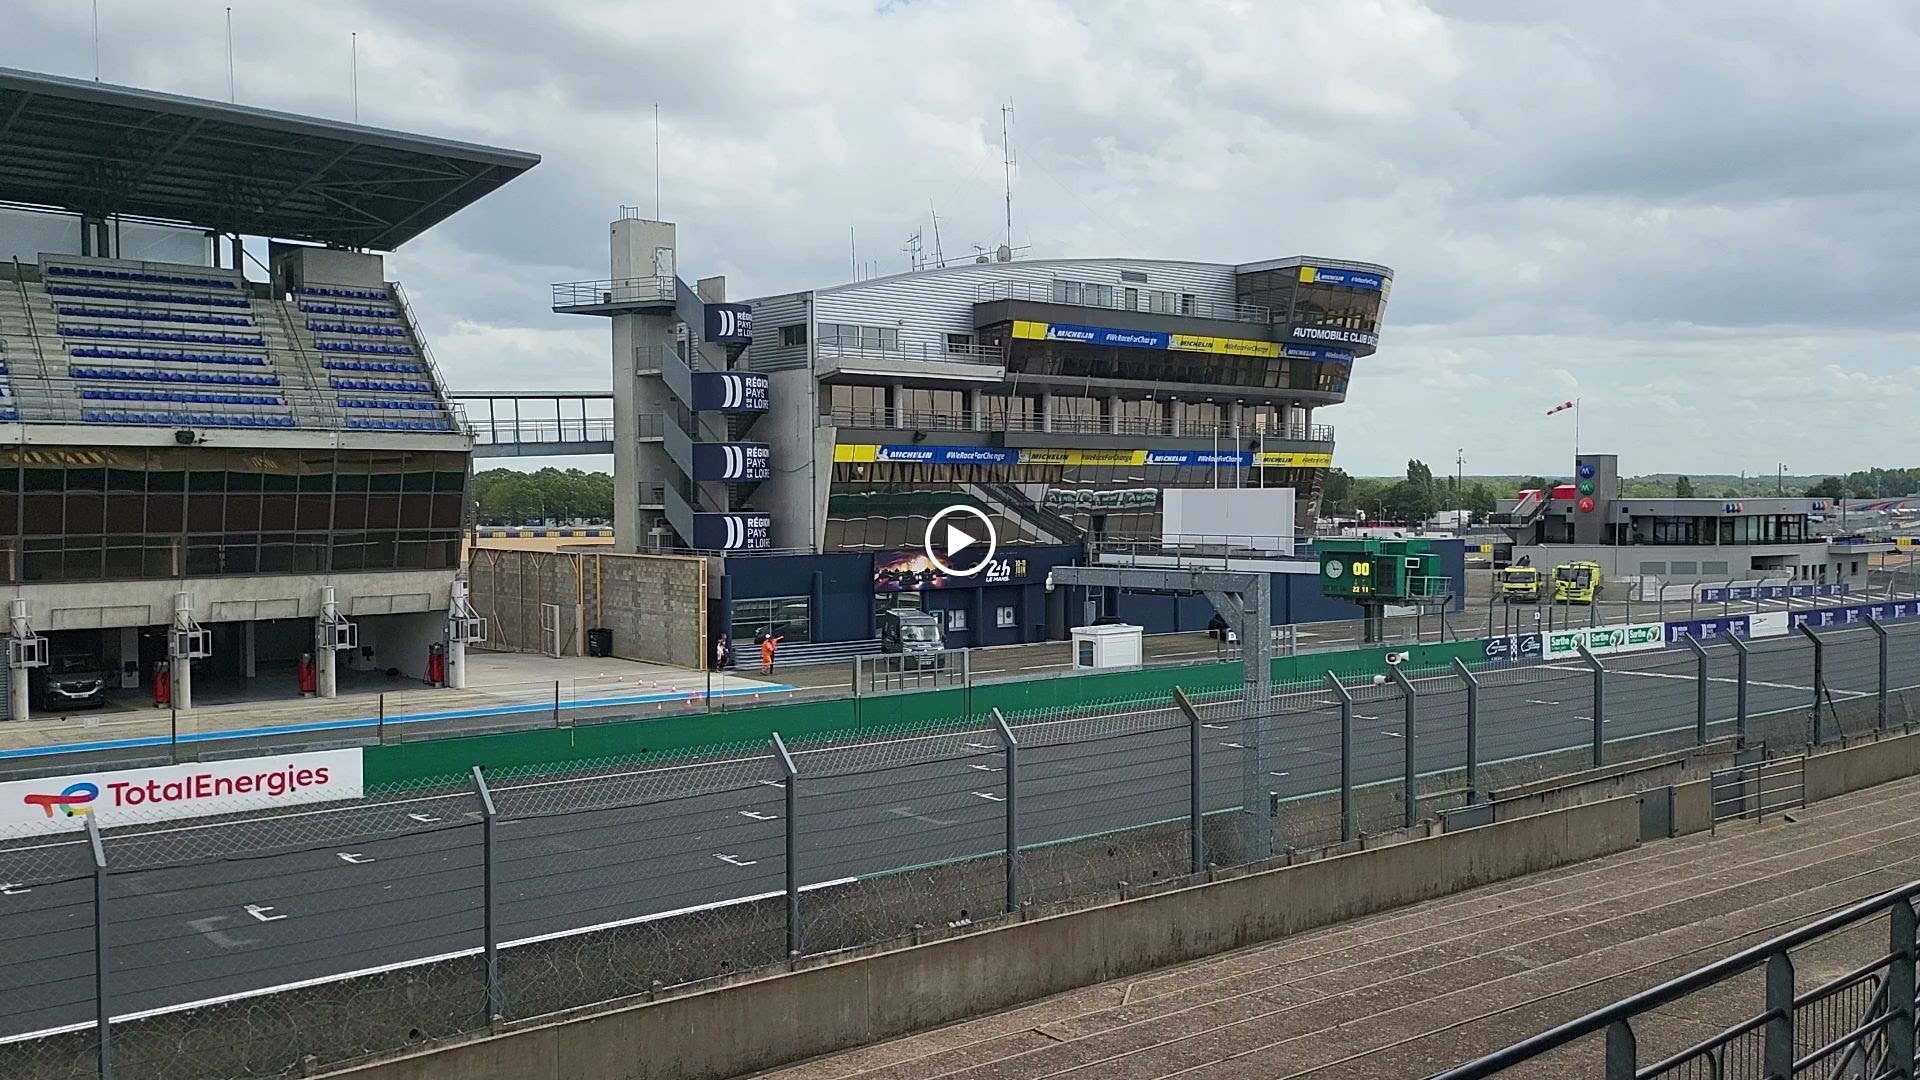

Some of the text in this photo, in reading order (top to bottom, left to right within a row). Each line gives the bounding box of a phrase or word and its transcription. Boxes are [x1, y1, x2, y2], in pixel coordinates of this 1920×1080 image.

[1057, 330, 1094, 339] MICHELIN
[1293, 327, 1349, 341] AUTOMOBILE
[1350, 332, 1367, 344] CLUB
[1180, 340, 1213, 349] MICHELIN
[745, 388, 765, 398] PAYS
[890, 451, 1005, 461] MICHELIN #WeRaceForChange
[746, 458, 765, 467] PAYS
[747, 528, 766, 537] PAYS
[1352, 562, 1370, 576] 00
[107, 764, 329, 806] TotalEnergies
